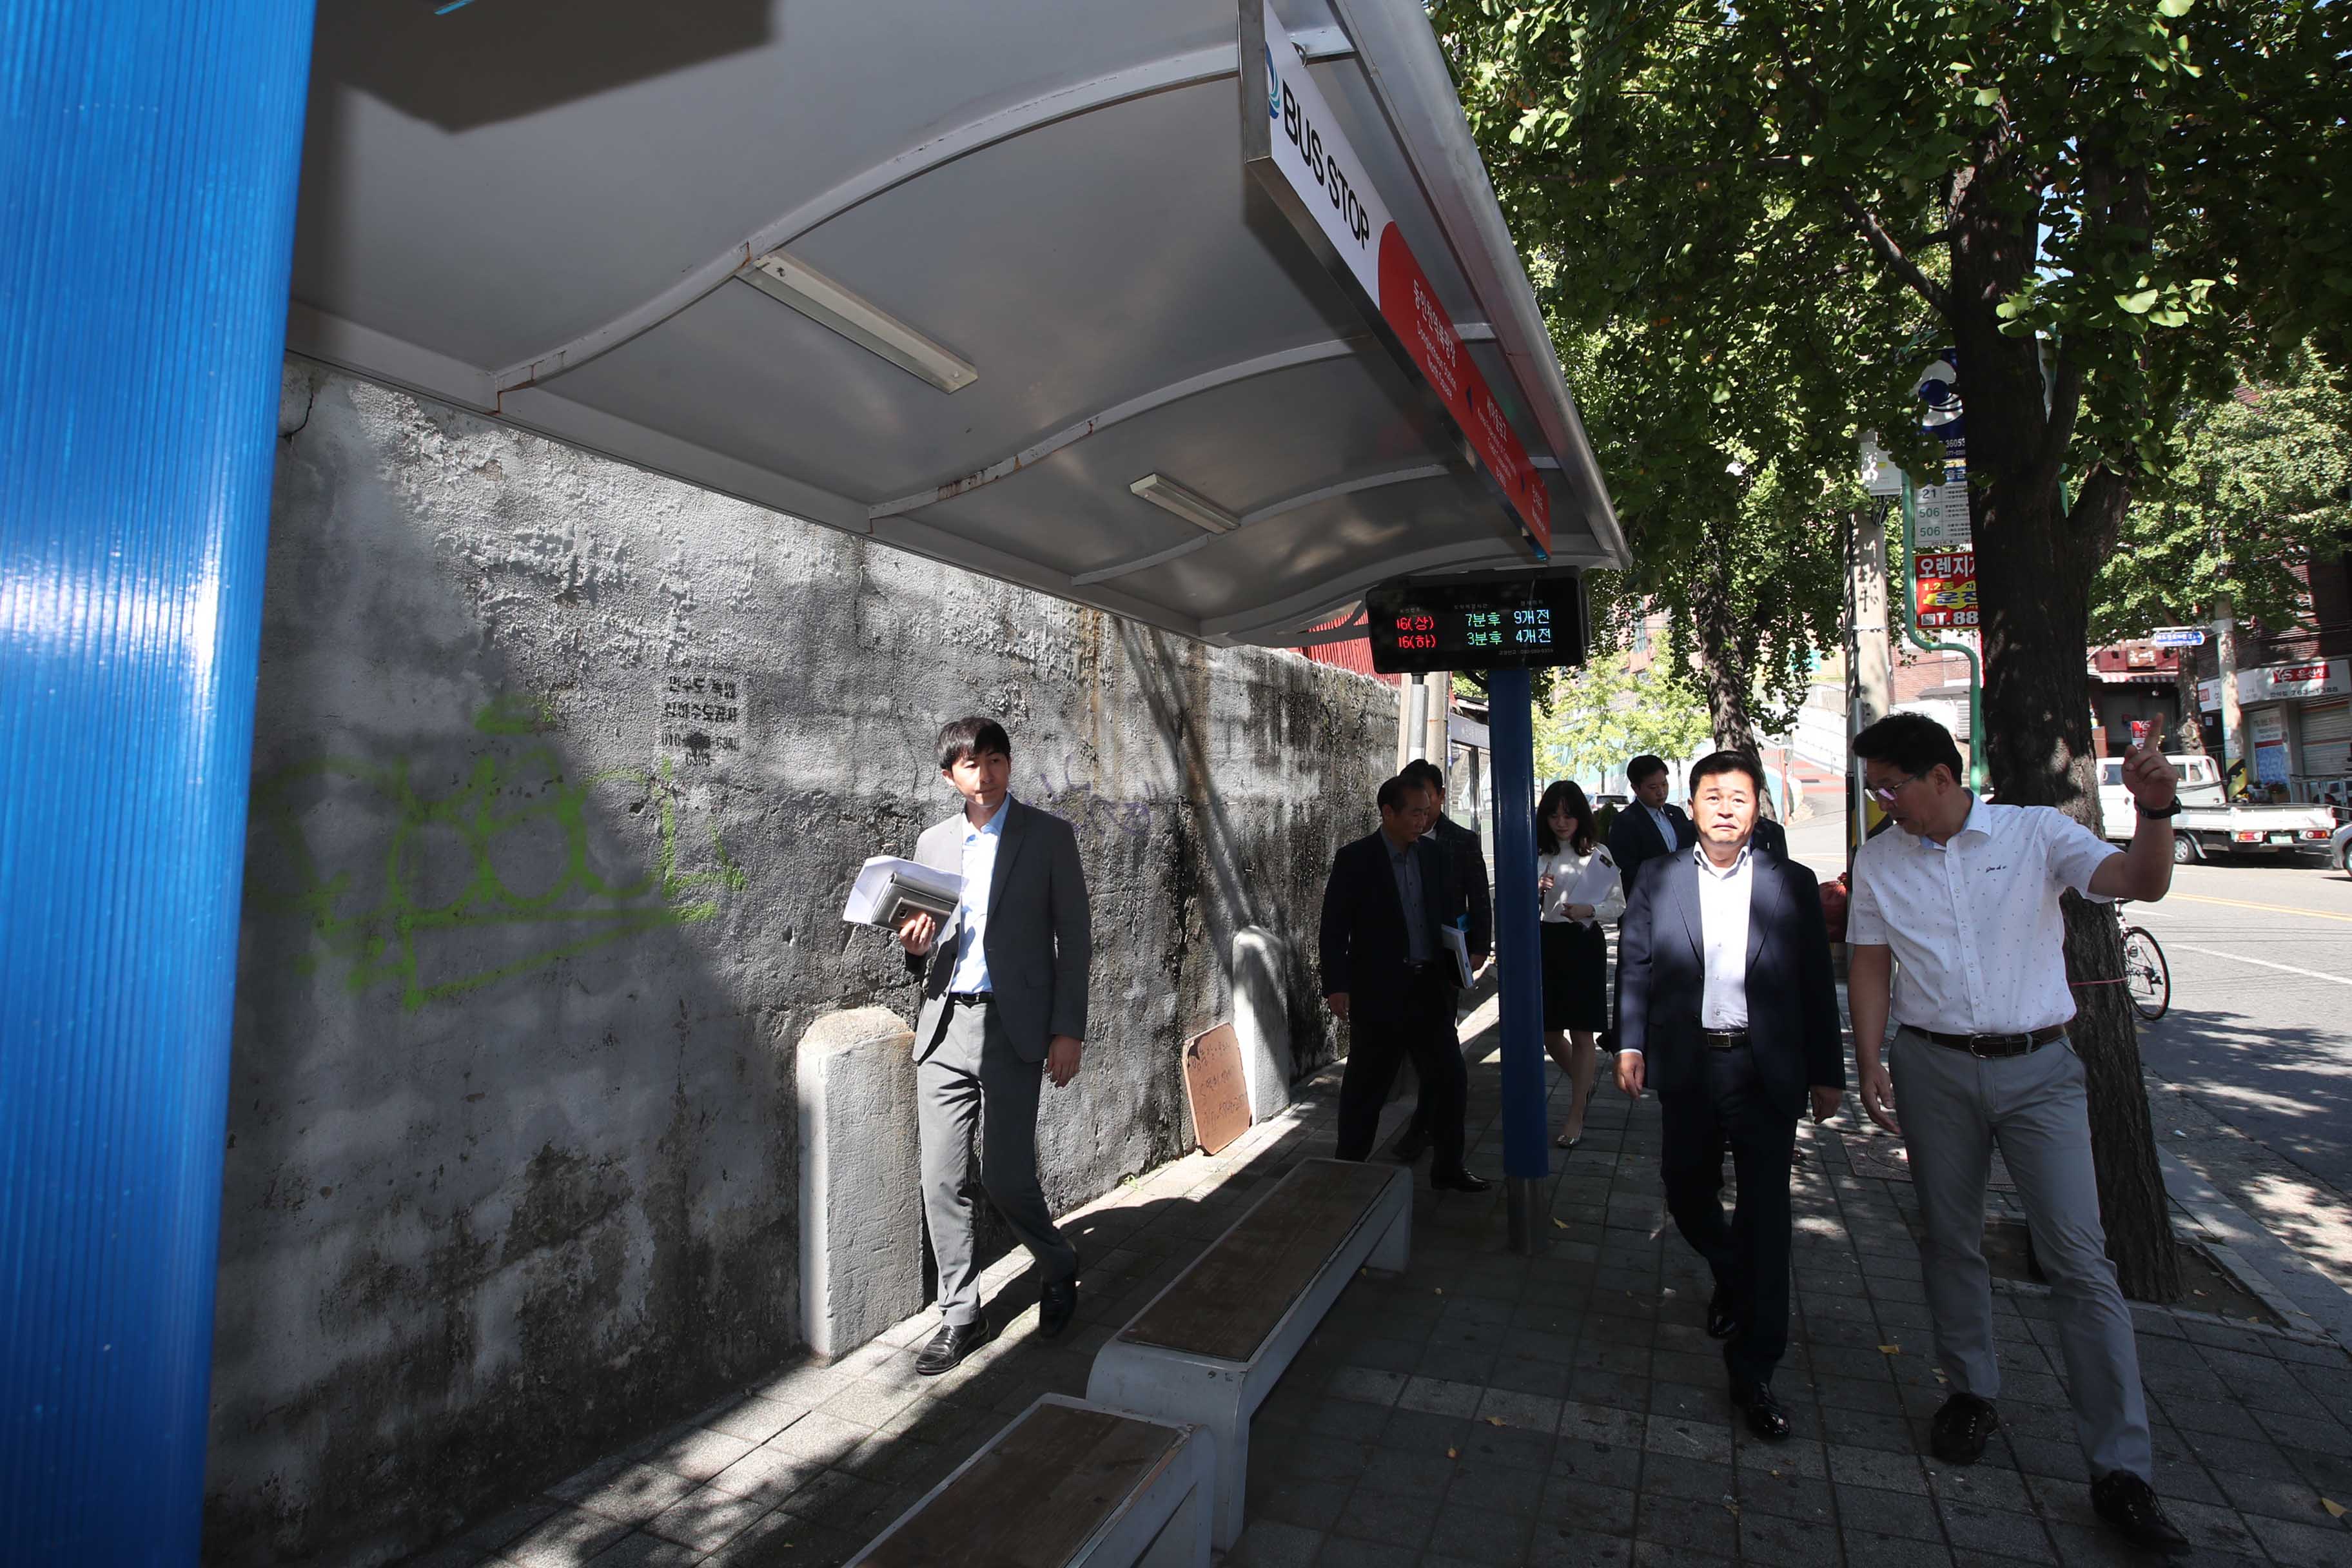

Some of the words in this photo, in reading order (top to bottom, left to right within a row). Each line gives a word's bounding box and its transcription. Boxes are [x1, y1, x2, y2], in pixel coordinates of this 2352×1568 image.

[1282, 78, 1324, 186] BUS
[1327, 154, 1370, 250] STOP
[1922, 488, 1937, 499] 21
[1919, 507, 1941, 518] 506
[1920, 526, 1941, 537] 506
[1396, 616, 1434, 631] 16(상)
[1398, 634, 1436, 649] 16(하)
